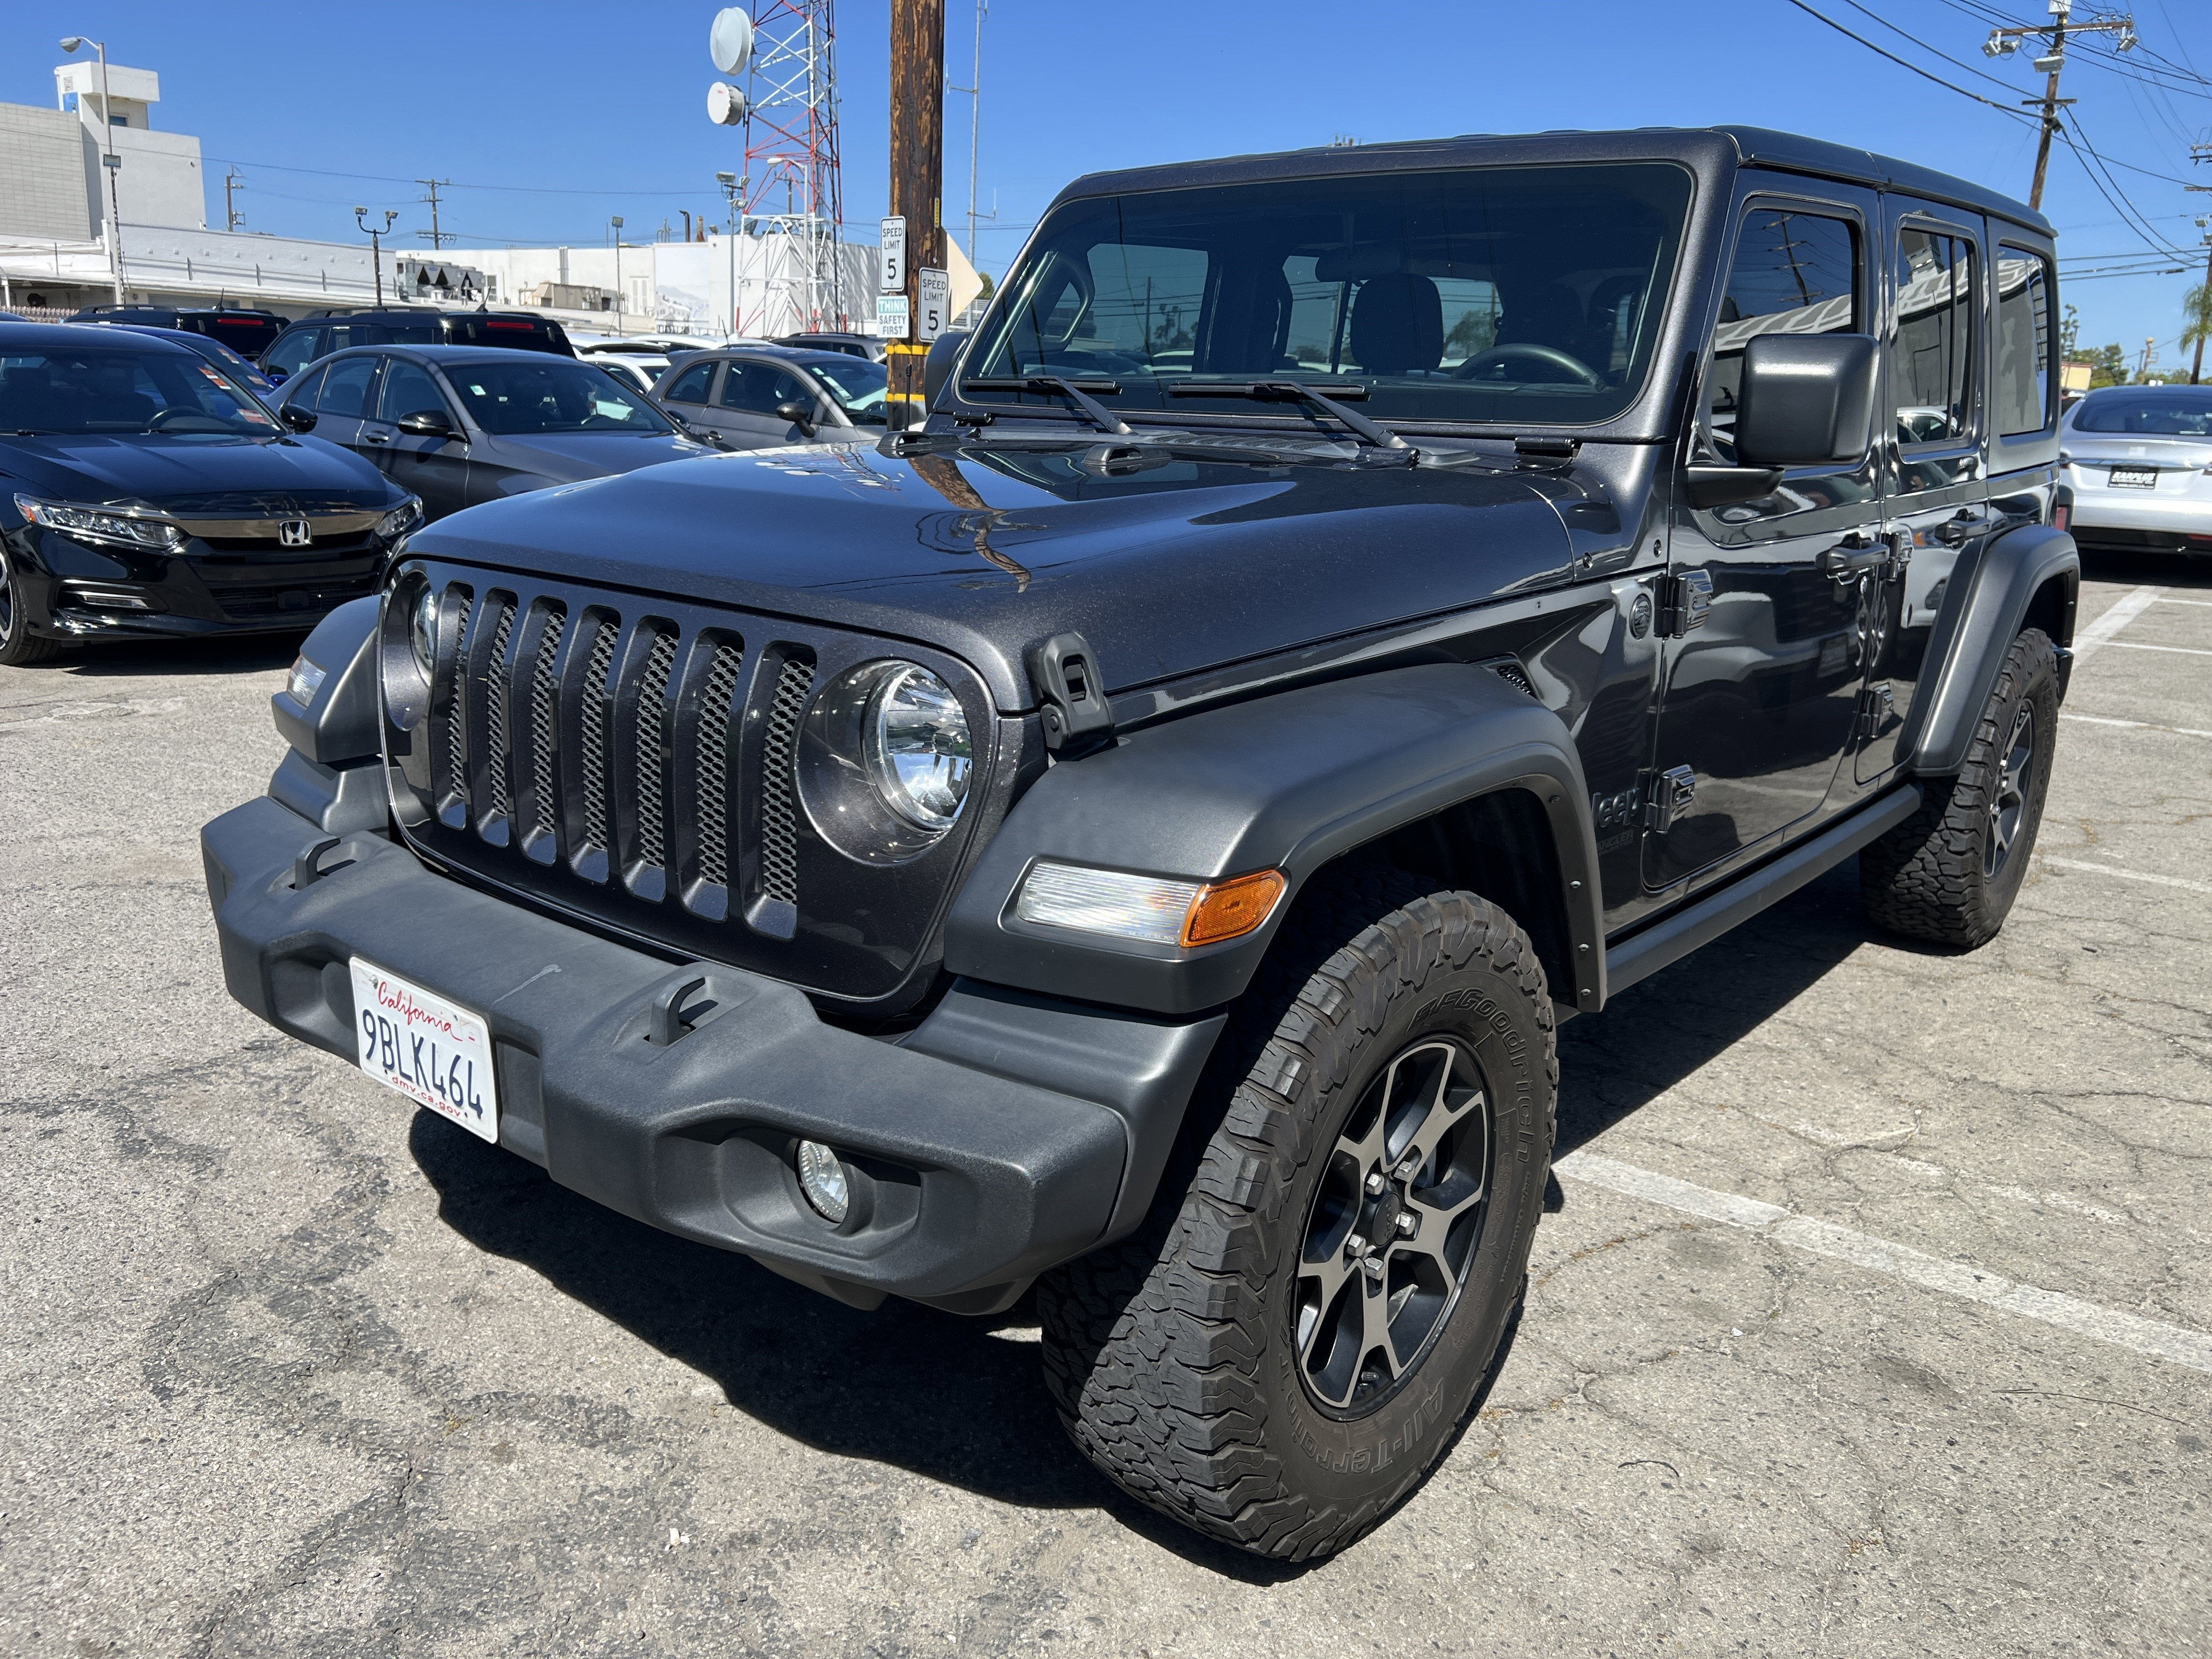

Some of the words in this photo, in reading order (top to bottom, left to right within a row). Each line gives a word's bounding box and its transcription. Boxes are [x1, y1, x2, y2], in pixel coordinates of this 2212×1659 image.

[883, 228, 902, 237] SPEED
[884, 240, 900, 250] LIMIT
[888, 258, 896, 279] 5
[923, 279, 946, 290] SPEED
[924, 291, 944, 302] LIMIT
[879, 300, 906, 312] THINK
[879, 315, 906, 325] SAFETY
[928, 310, 938, 331] 5
[883, 326, 902, 335] FIRST
[1592, 787, 1640, 829] Jeep
[378, 981, 463, 1042] California
[362, 1009, 483, 1120] 9BLK464
[1404, 988, 1535, 1163] BFGoodrich
[392, 1076, 461, 1118] dmv.ca.gov
